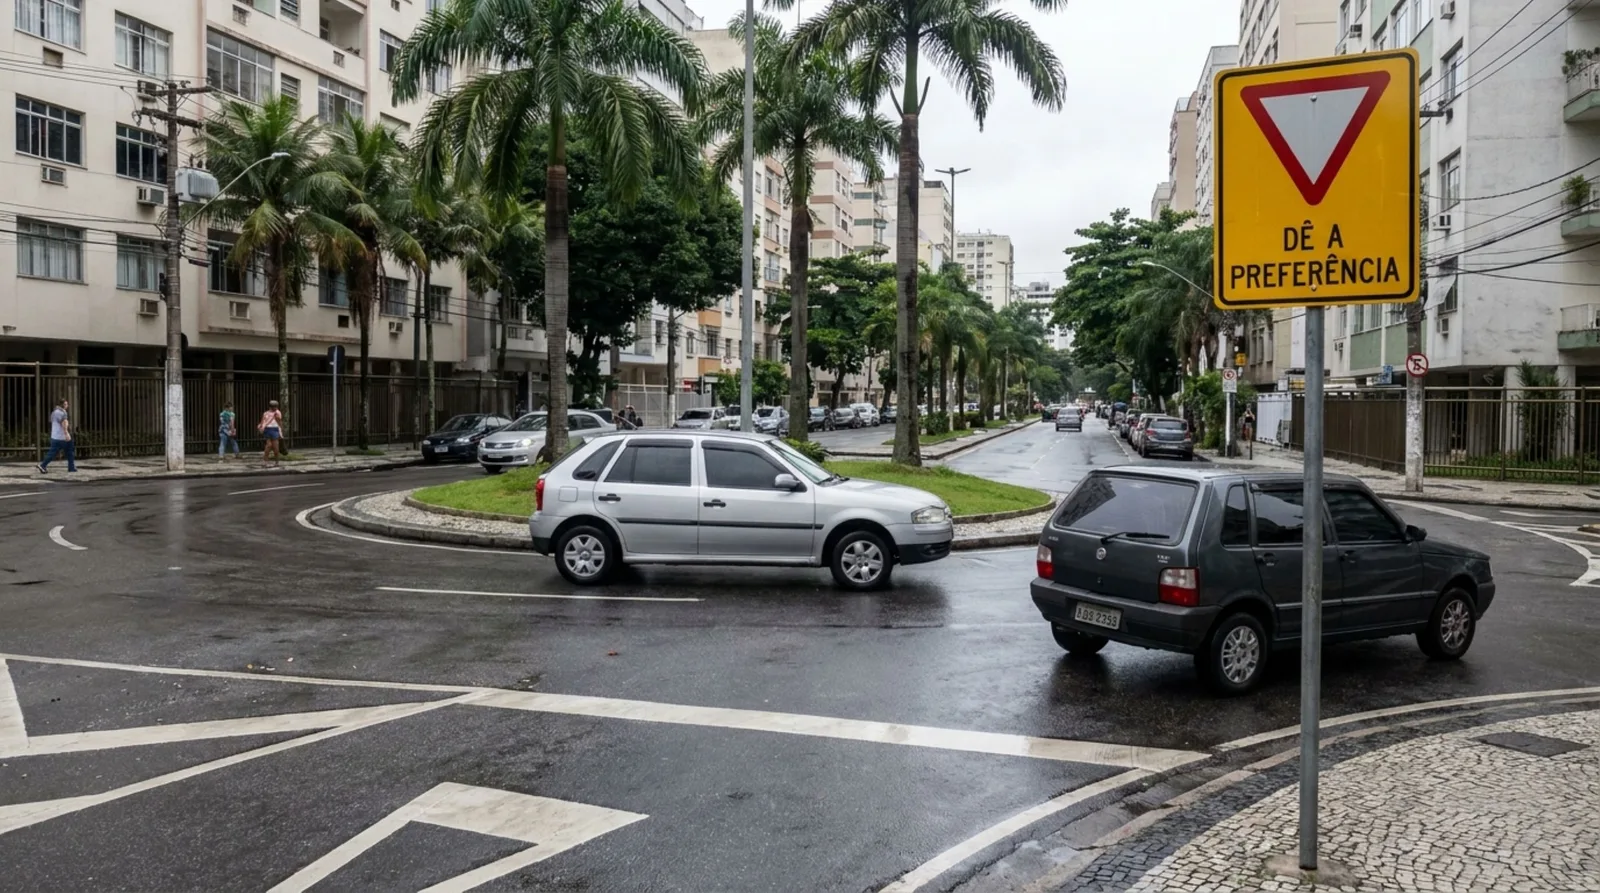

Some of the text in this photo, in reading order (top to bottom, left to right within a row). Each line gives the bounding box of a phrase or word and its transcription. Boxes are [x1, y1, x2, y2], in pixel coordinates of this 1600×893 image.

[1283, 219, 1344, 251] DÊ A
[1230, 253, 1400, 289] PREFERÊNCIA
